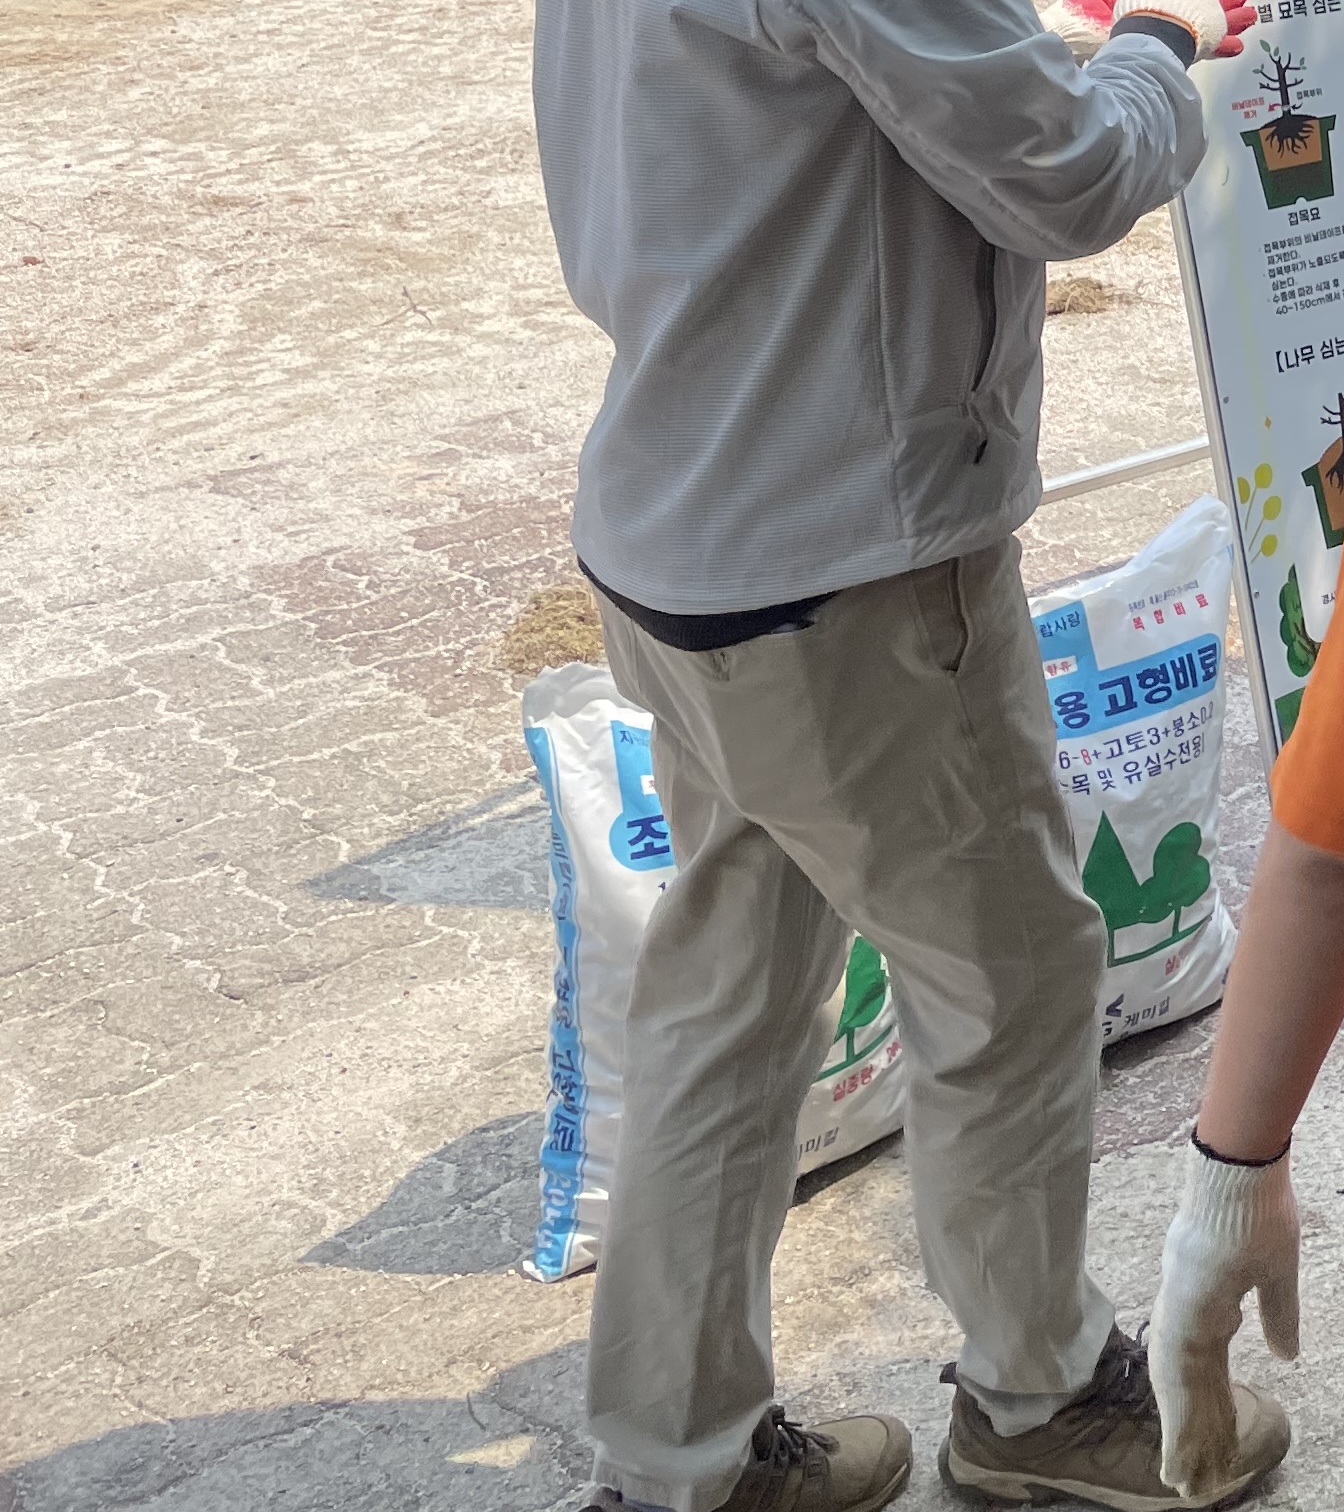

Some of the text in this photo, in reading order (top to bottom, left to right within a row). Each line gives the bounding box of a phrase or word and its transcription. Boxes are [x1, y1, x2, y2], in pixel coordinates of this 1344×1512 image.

[1287, 207, 1321, 227] 접목묘
[1098, 642, 1218, 717] 고형비료
[1097, 767, 1117, 792] 및
